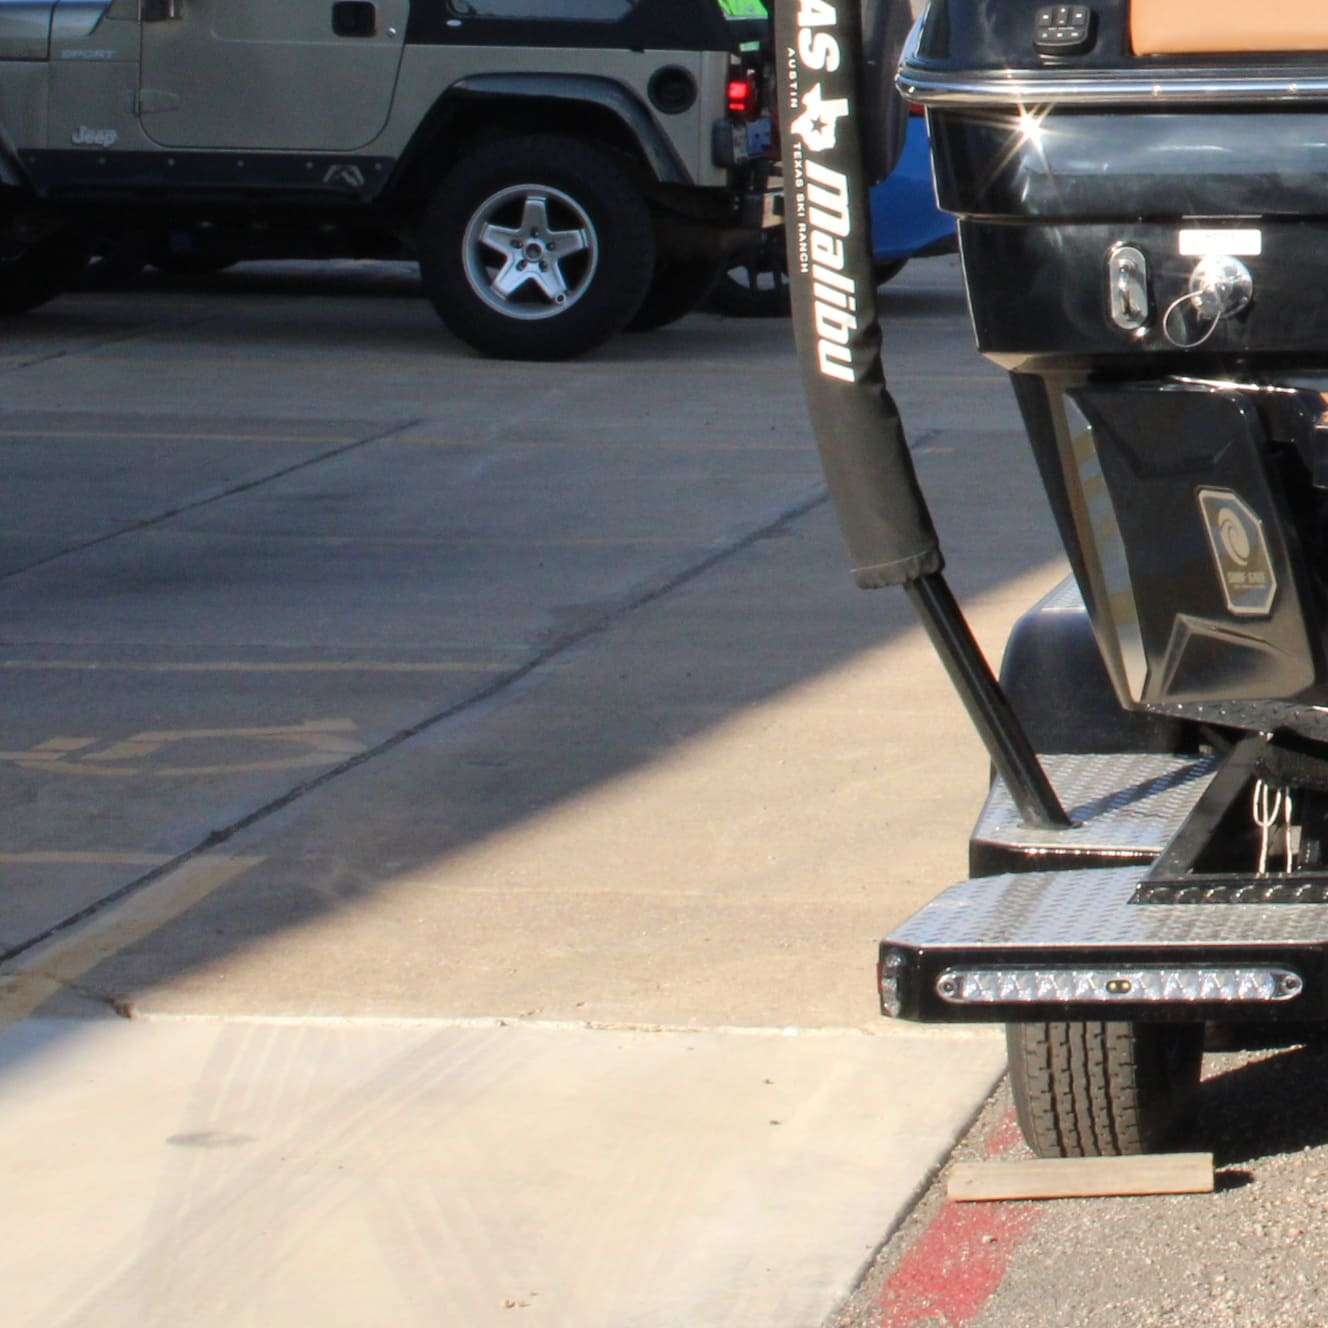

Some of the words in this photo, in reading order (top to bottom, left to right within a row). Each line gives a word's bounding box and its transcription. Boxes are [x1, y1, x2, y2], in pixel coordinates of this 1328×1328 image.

[787, 46, 799, 108] AUSTIN
[72, 126, 118, 147] Jeep
[793, 142, 804, 188] TEXAS
[795, 193, 806, 217] SKI
[797, 222, 809, 273] RANCH
